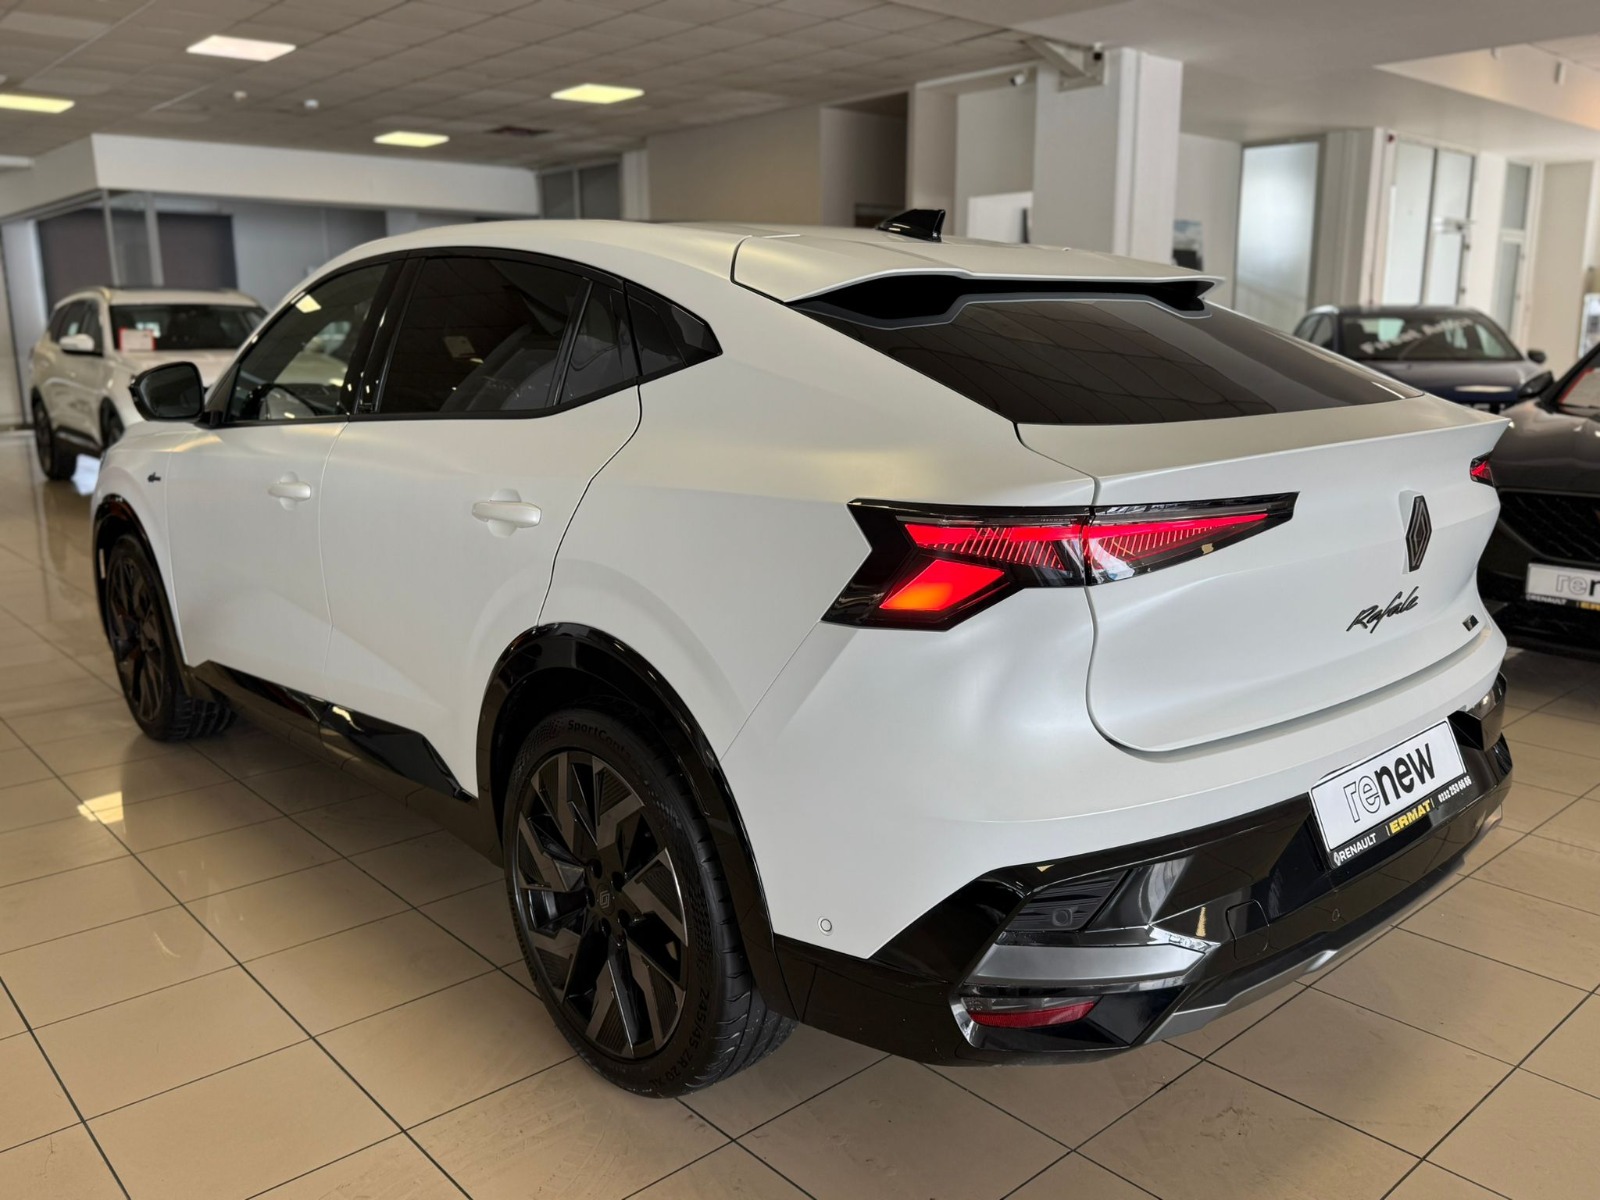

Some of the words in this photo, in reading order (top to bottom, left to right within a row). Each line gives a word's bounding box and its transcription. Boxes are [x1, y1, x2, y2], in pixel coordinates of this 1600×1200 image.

[1345, 586, 1419, 634] Rafale
[1343, 743, 1436, 823] renew
[1339, 833, 1377, 862] RENAULT
[1389, 800, 1432, 834] ERMAT
